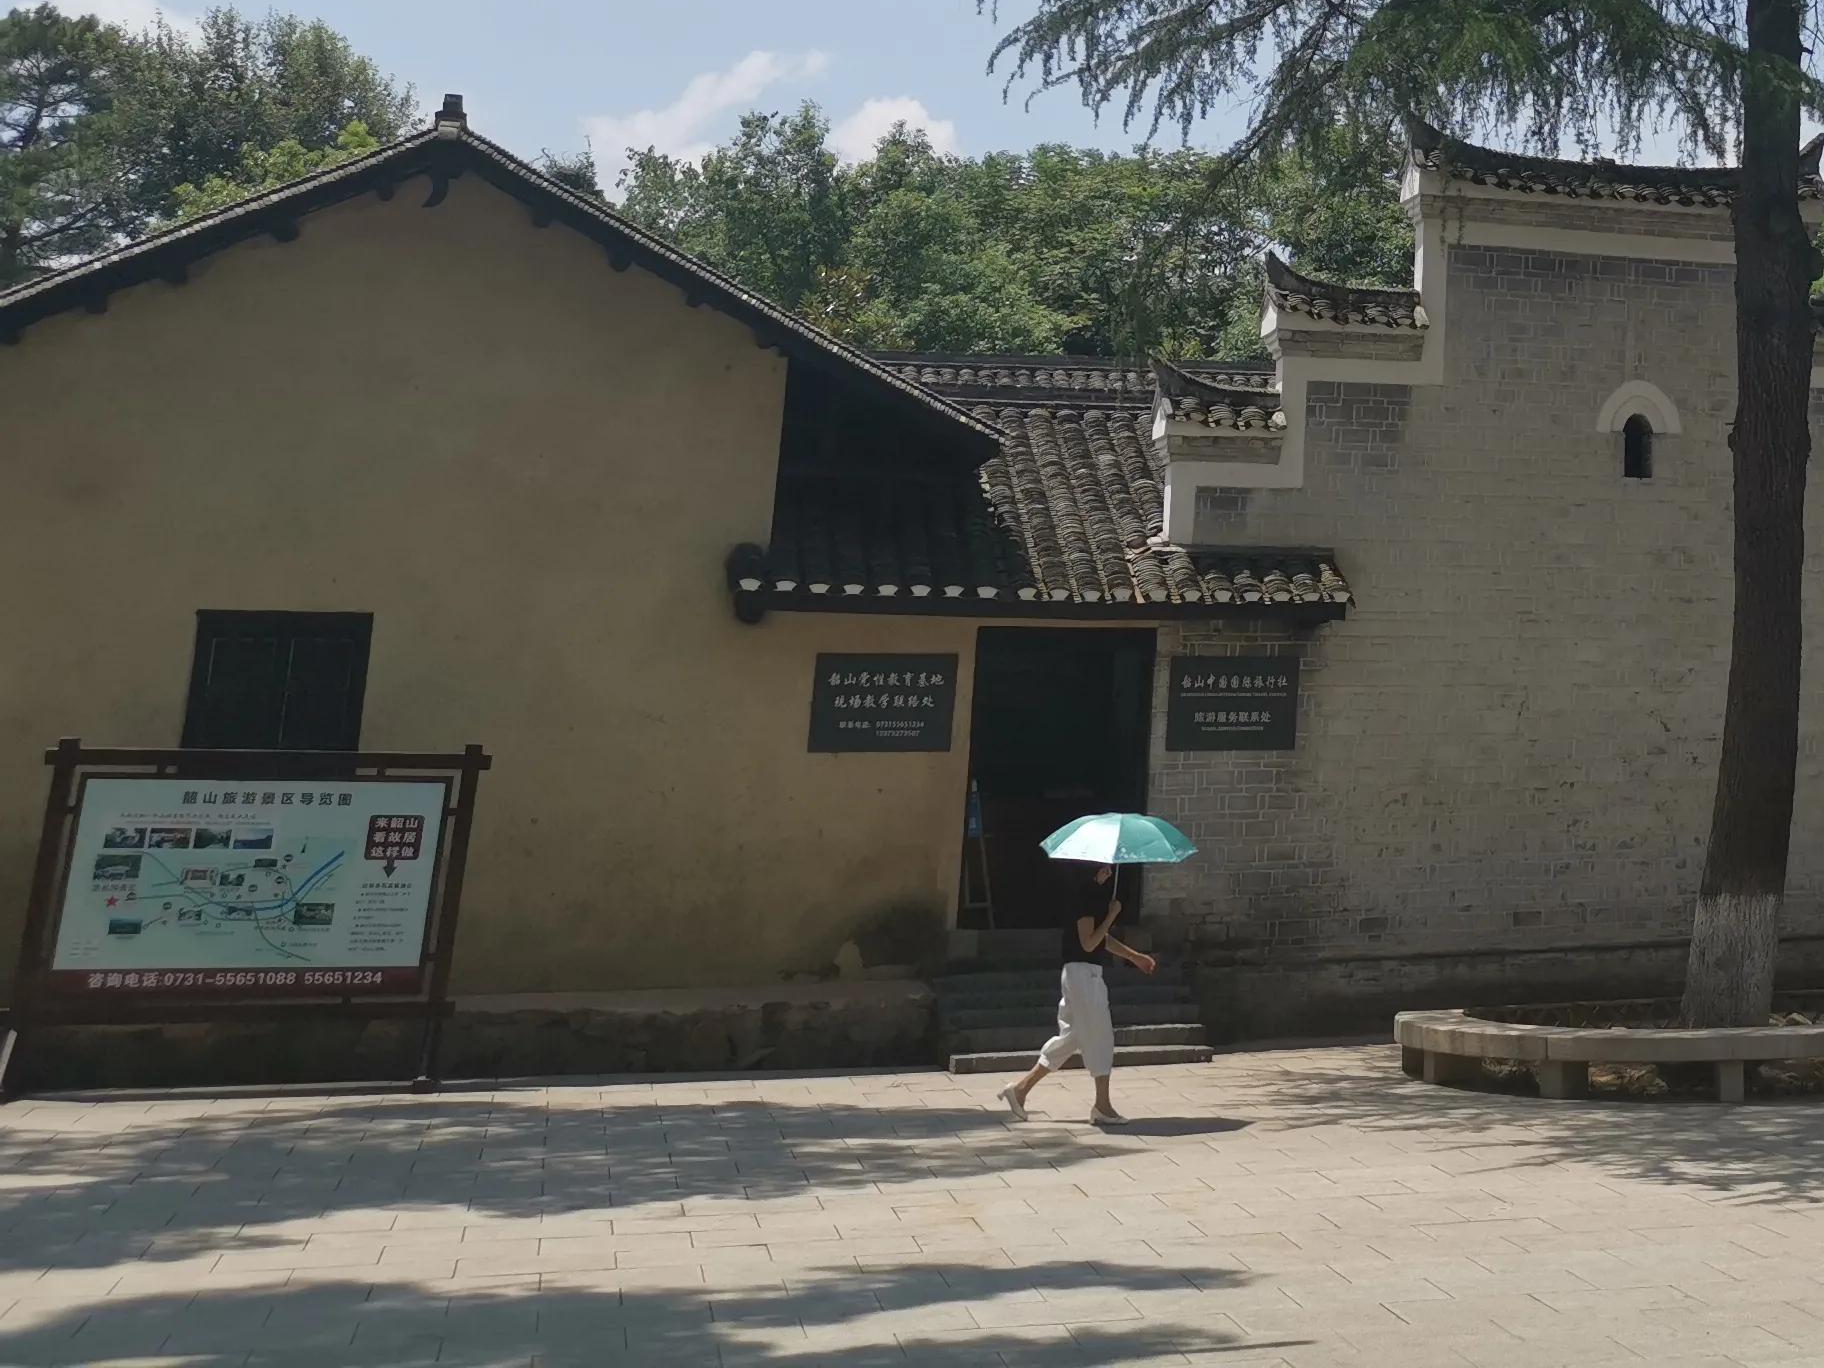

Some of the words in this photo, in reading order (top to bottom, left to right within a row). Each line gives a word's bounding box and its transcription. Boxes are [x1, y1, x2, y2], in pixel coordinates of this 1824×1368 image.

[181, 790, 354, 807] 韶山旅游景区导览图
[373, 816, 420, 829] 来韶山
[371, 830, 418, 844] 看故居
[369, 845, 416, 858] 这样做
[302, 970, 384, 986] 55651234
